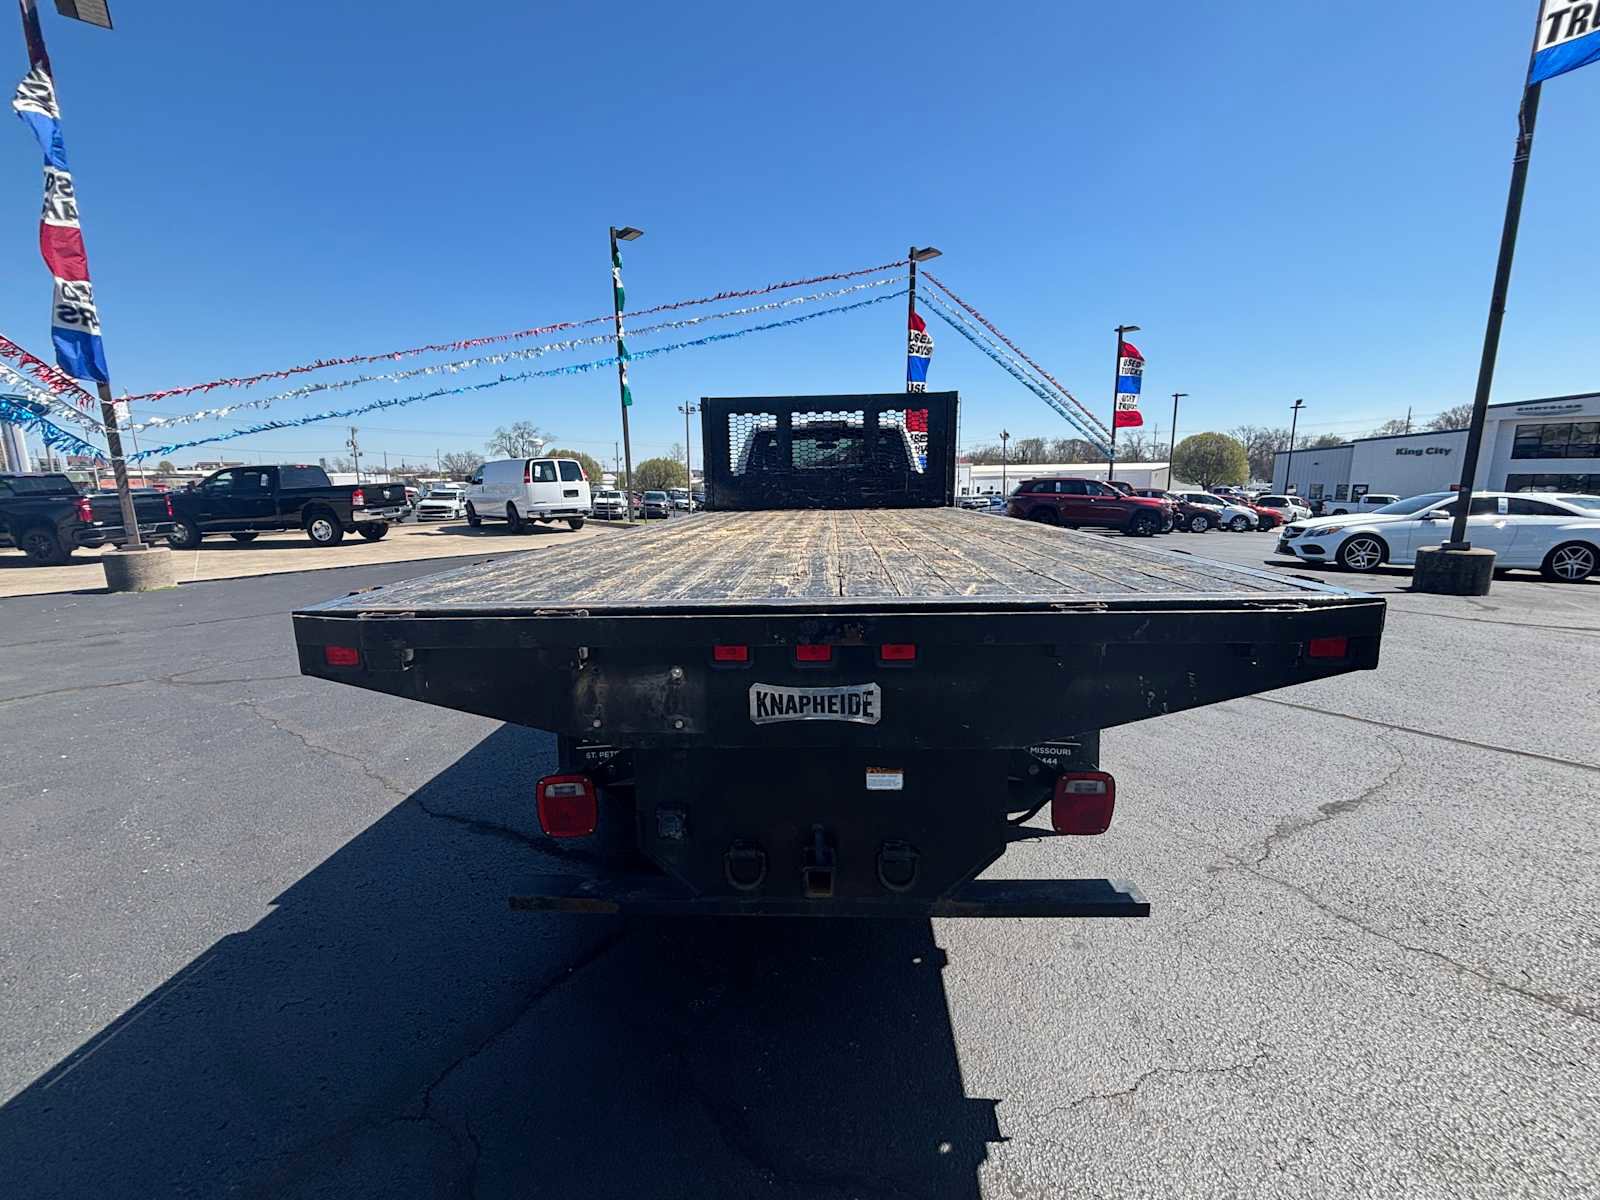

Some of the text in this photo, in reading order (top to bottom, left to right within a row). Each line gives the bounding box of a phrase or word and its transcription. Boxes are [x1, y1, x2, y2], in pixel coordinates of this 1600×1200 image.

[907, 383, 926, 393] USE
[1396, 447, 1452, 457] King City
[756, 690, 874, 718] KNAPHEIDE
[1030, 747, 1072, 756] MISSOURI
[1041, 757, 1058, 765] 444
